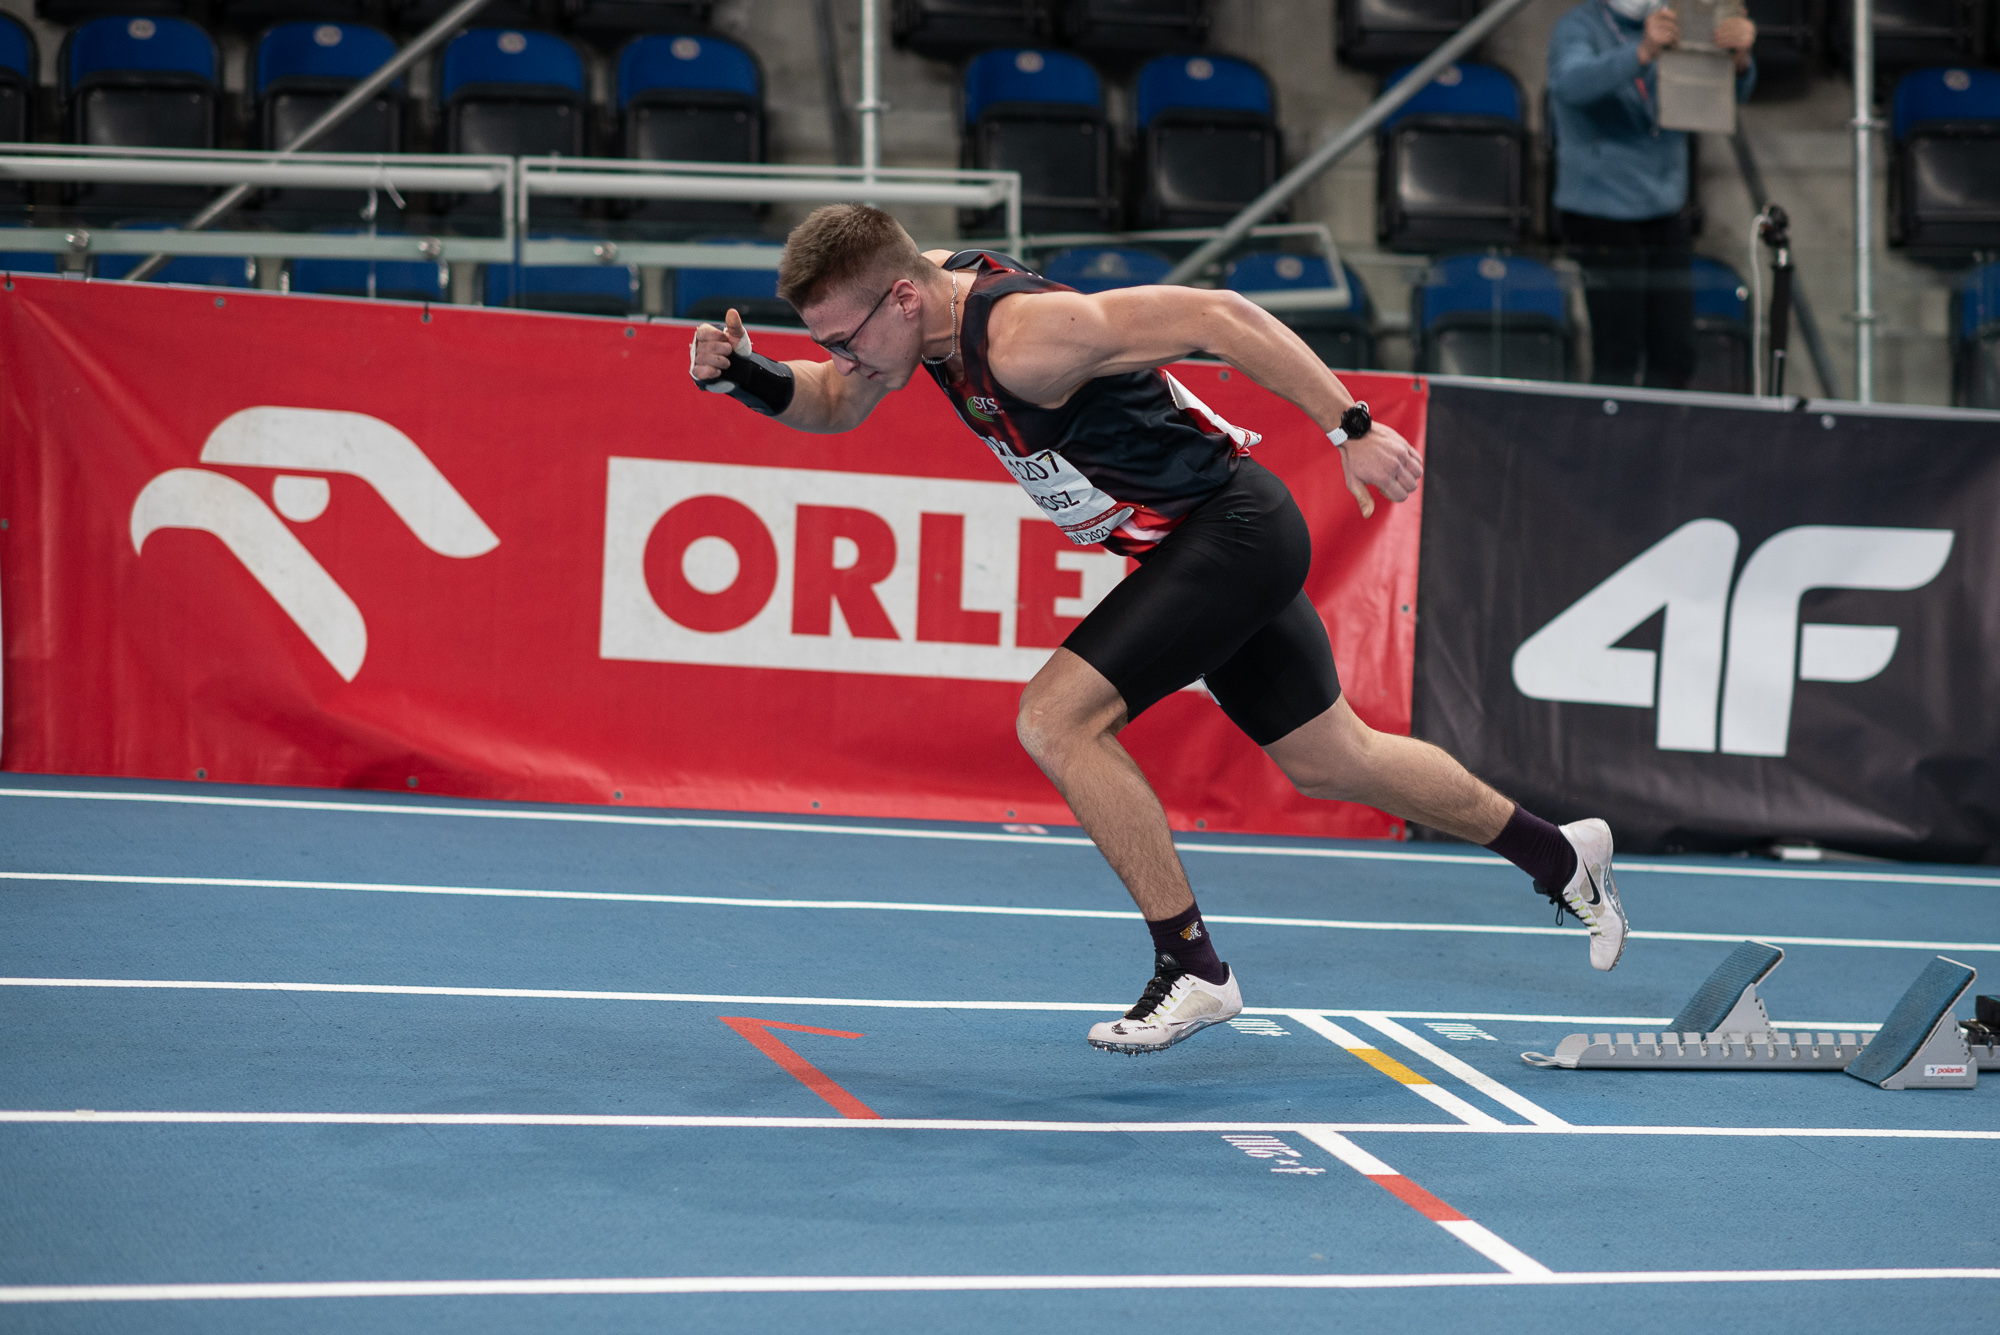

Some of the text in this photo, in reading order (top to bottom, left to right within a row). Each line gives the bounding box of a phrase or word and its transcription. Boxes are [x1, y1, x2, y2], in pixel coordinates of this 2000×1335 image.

[973, 396, 998, 410] STS
[1008, 451, 1060, 481] 1207
[1086, 526, 1111, 541] 2021
[643, 494, 1142, 650] ORLE
[1512, 518, 1955, 757] 4F
